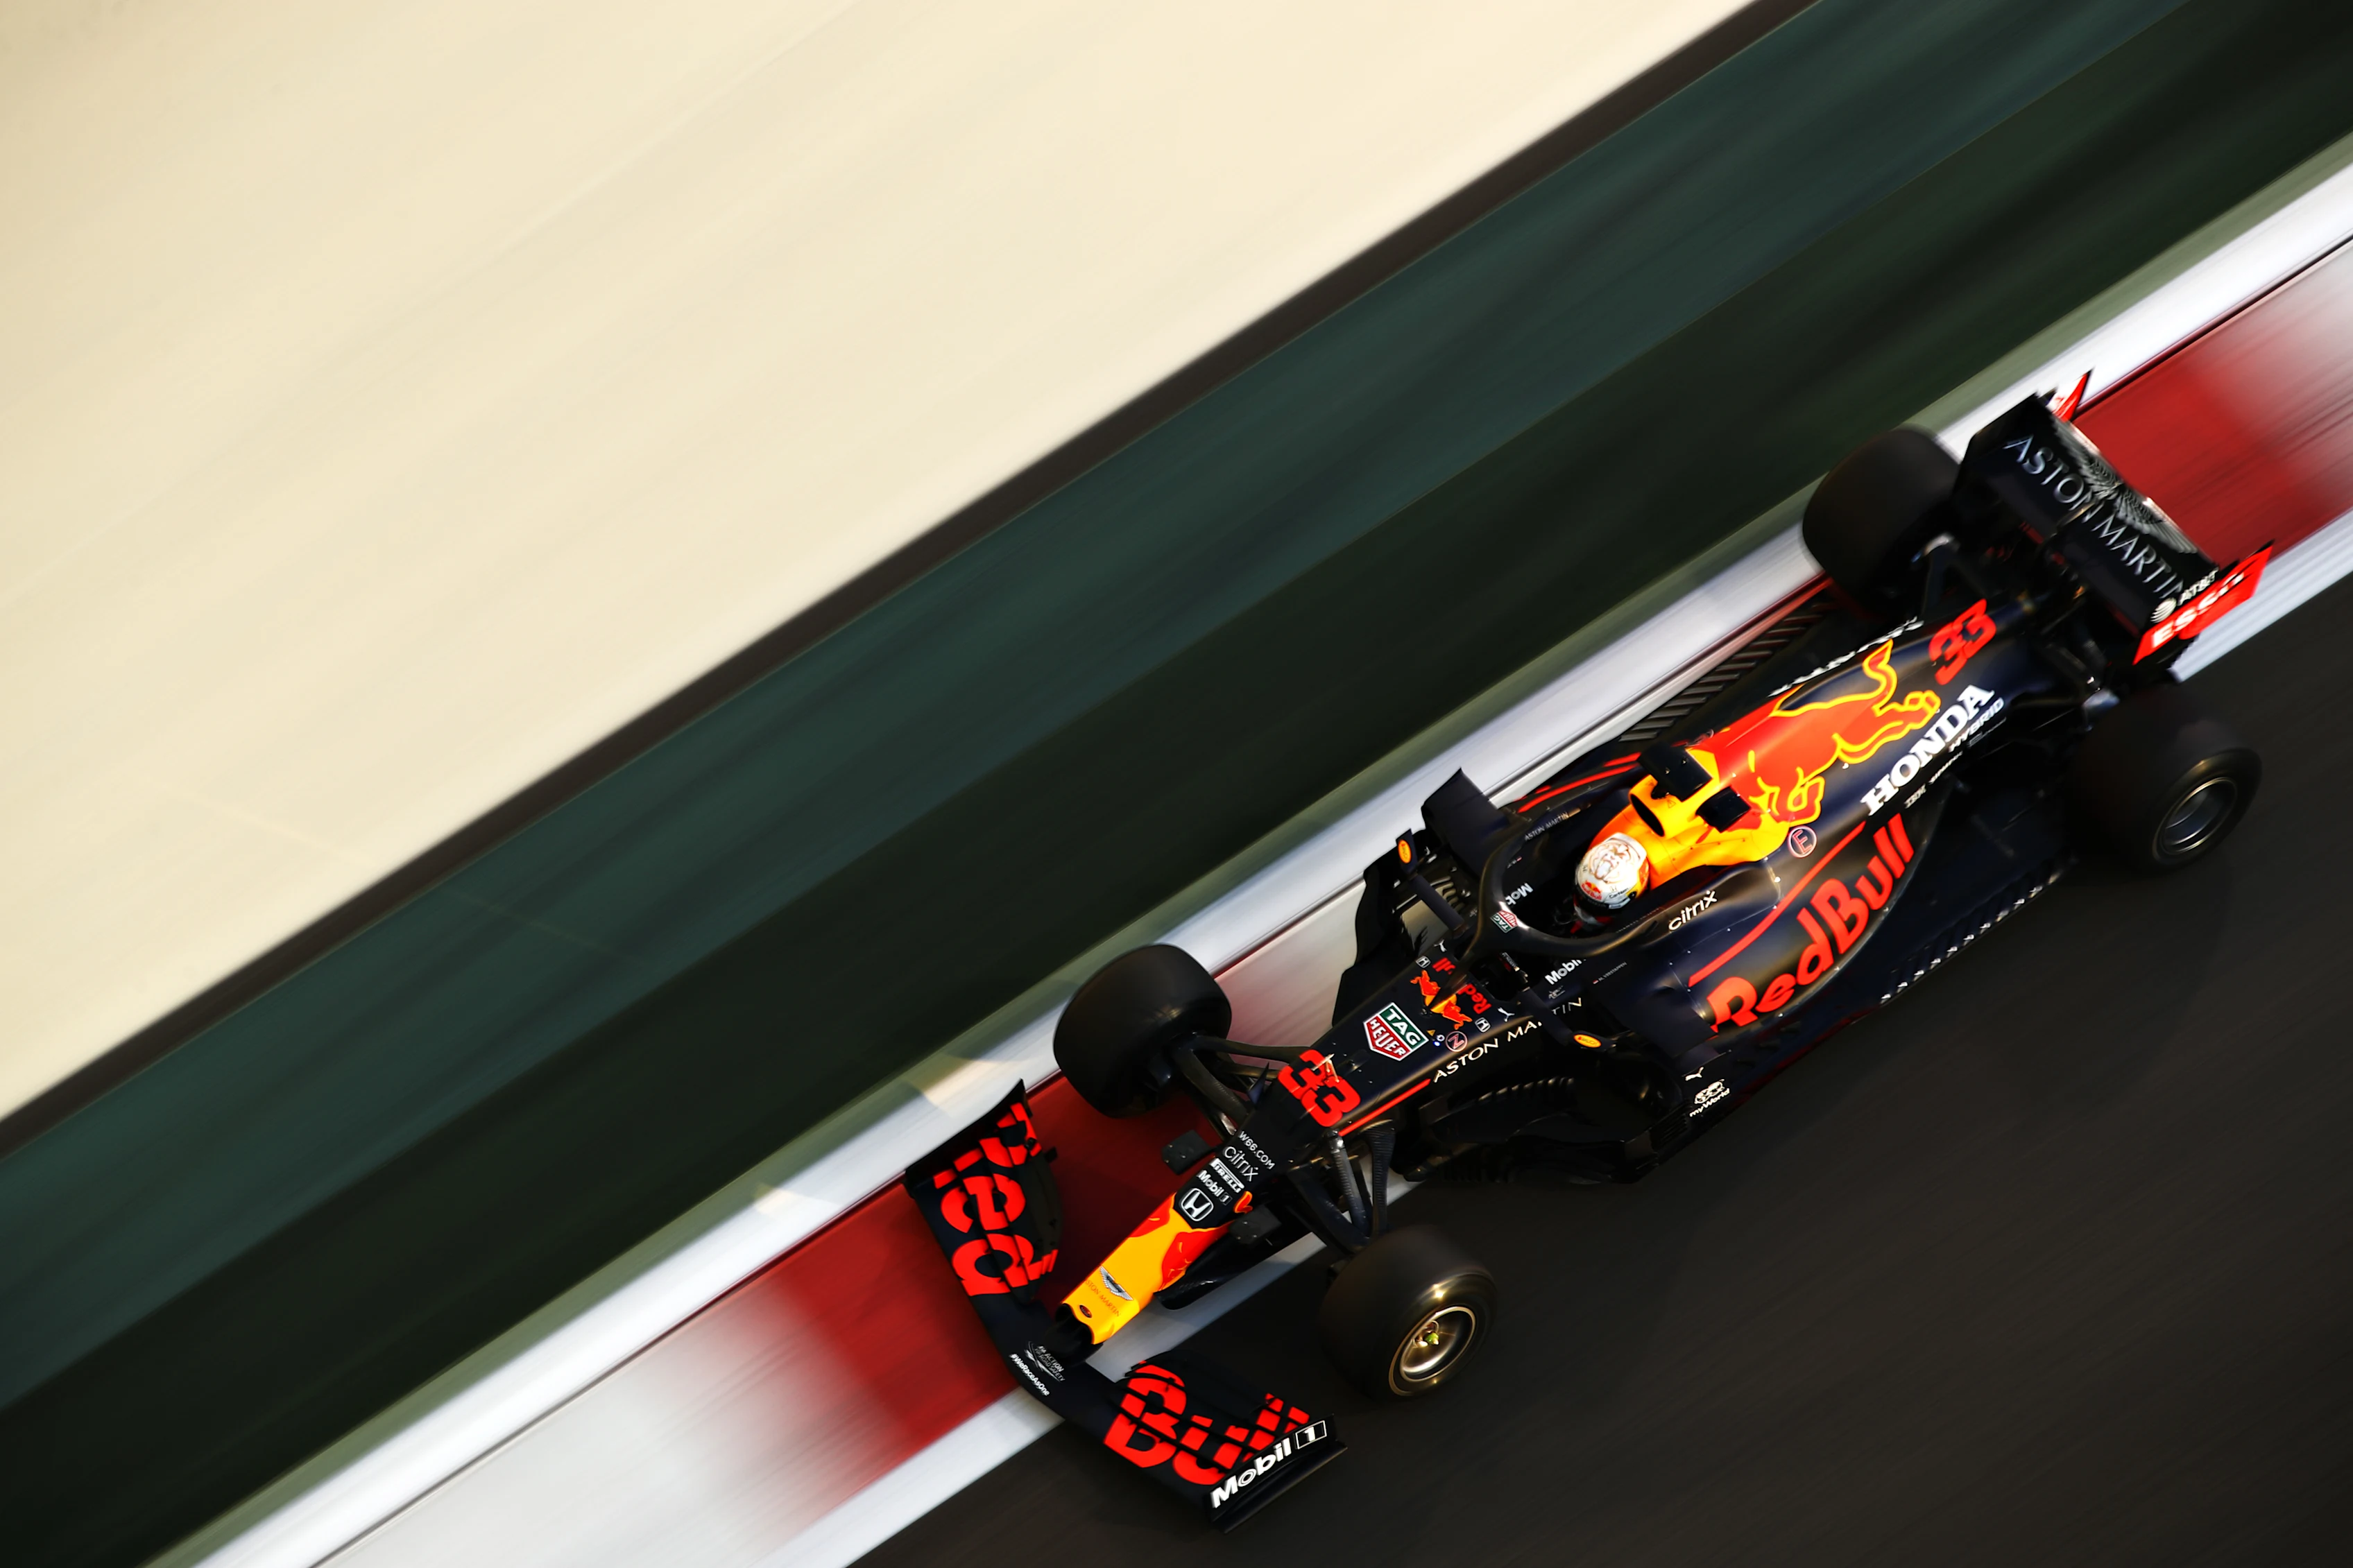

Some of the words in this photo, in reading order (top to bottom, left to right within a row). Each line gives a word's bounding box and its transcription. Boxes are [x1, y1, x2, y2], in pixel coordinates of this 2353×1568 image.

[2003, 434, 2104, 523] ASTON
[1928, 598, 1996, 685] 33
[1948, 698, 2005, 753] HYBRID
[1860, 684, 1995, 816] HONDA
[1505, 883, 1534, 906] Mob
[1668, 890, 1718, 931] citrix
[1494, 915, 1509, 931] TAG
[1432, 957, 1456, 975] ull
[1457, 983, 1491, 1014] Red
[1370, 1019, 1407, 1056] HEUER
[1387, 1008, 1421, 1046] TAG
[1433, 1038, 1498, 1083] ASTON
[1507, 997, 1582, 1042] MATIN
[1278, 1049, 1361, 1127] 33
[1238, 1131, 1275, 1170] W66.COM
[1197, 1170, 1224, 1197] Mobil
[1210, 1157, 1244, 1193] PIRELLI
[1086, 1279, 1102, 1295] STON
[1010, 1353, 1050, 1396] #WeRaceAsOne
[1045, 1353, 1064, 1372] ACTION
[1049, 1365, 1066, 1381] SAFETY
[1210, 1437, 1292, 1508] Mobil
